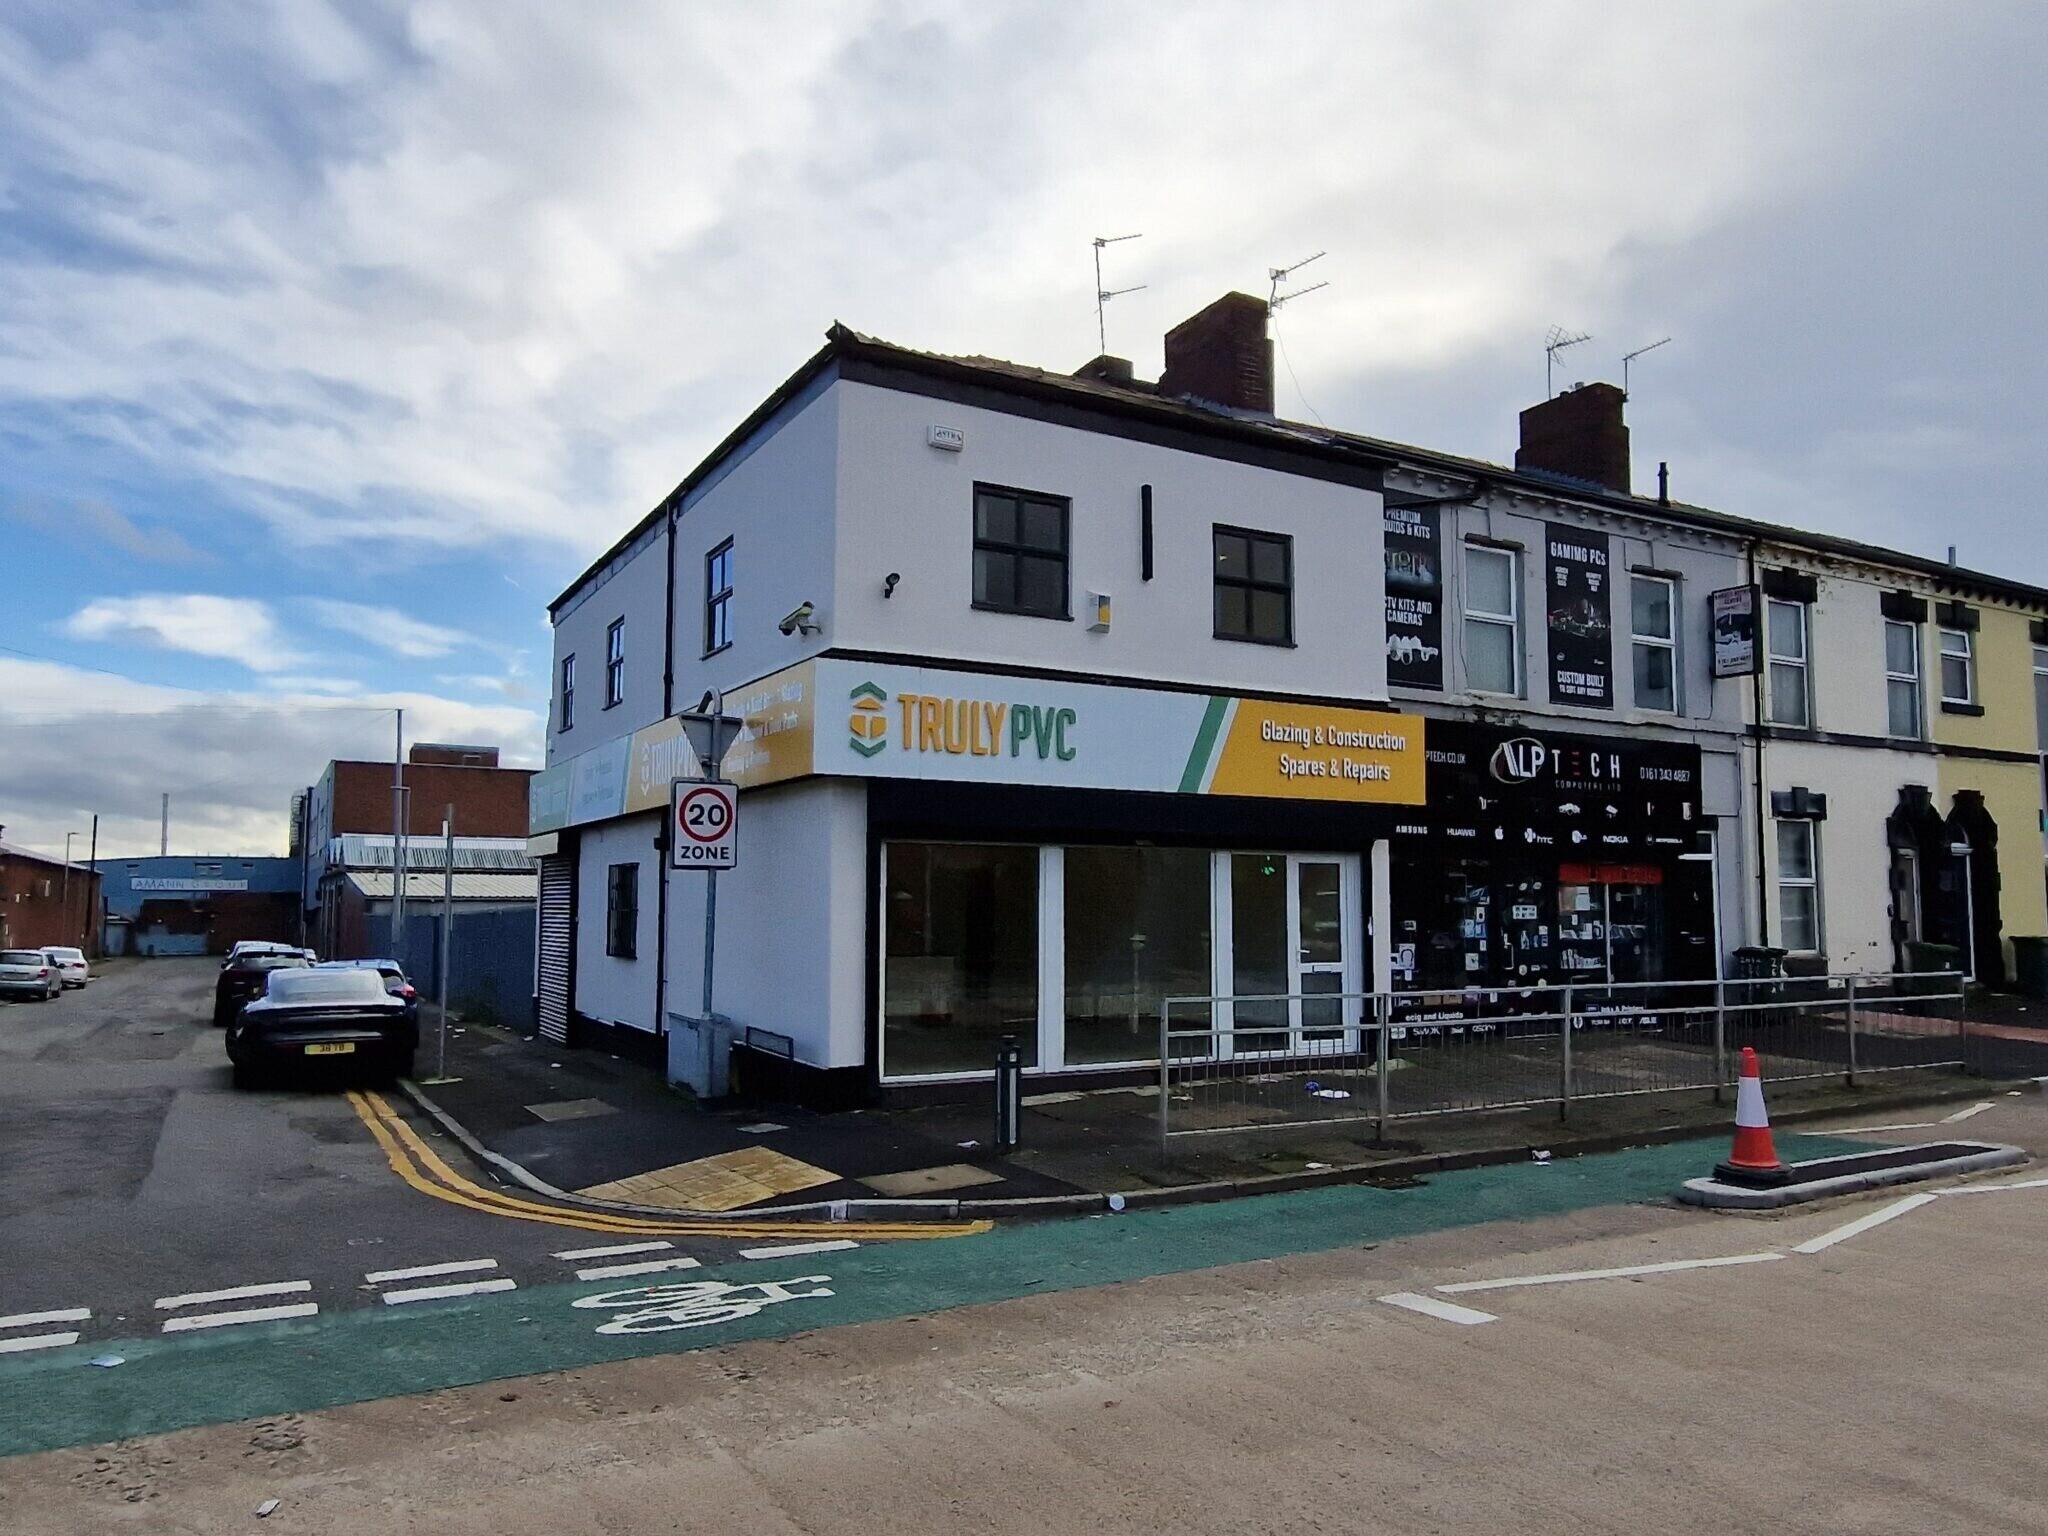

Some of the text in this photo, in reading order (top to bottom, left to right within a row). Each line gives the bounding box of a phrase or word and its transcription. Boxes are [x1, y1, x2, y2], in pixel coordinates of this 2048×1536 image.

[1413, 524, 1431, 540] KITS
[1589, 548, 1606, 566] PCs
[1398, 598, 1415, 612] KITS
[1416, 600, 1432, 615] AND
[1387, 609, 1423, 627] CAMERAS
[1557, 669, 1605, 688] CUSTOM BUILT
[1261, 720, 1406, 751] Glazing & Construction
[1279, 753, 1391, 784] Spares & Repairs
[1639, 766, 1657, 780] 0161
[688, 804, 726, 826] 20
[1446, 827, 1476, 837] HUAWEI
[1602, 835, 1629, 844] NOKIA
[681, 846, 729, 859] ZONE
[135, 879, 184, 889] AMANN
[1405, 1013, 1422, 1022] ecig
[1423, 1012, 1437, 1020] and
